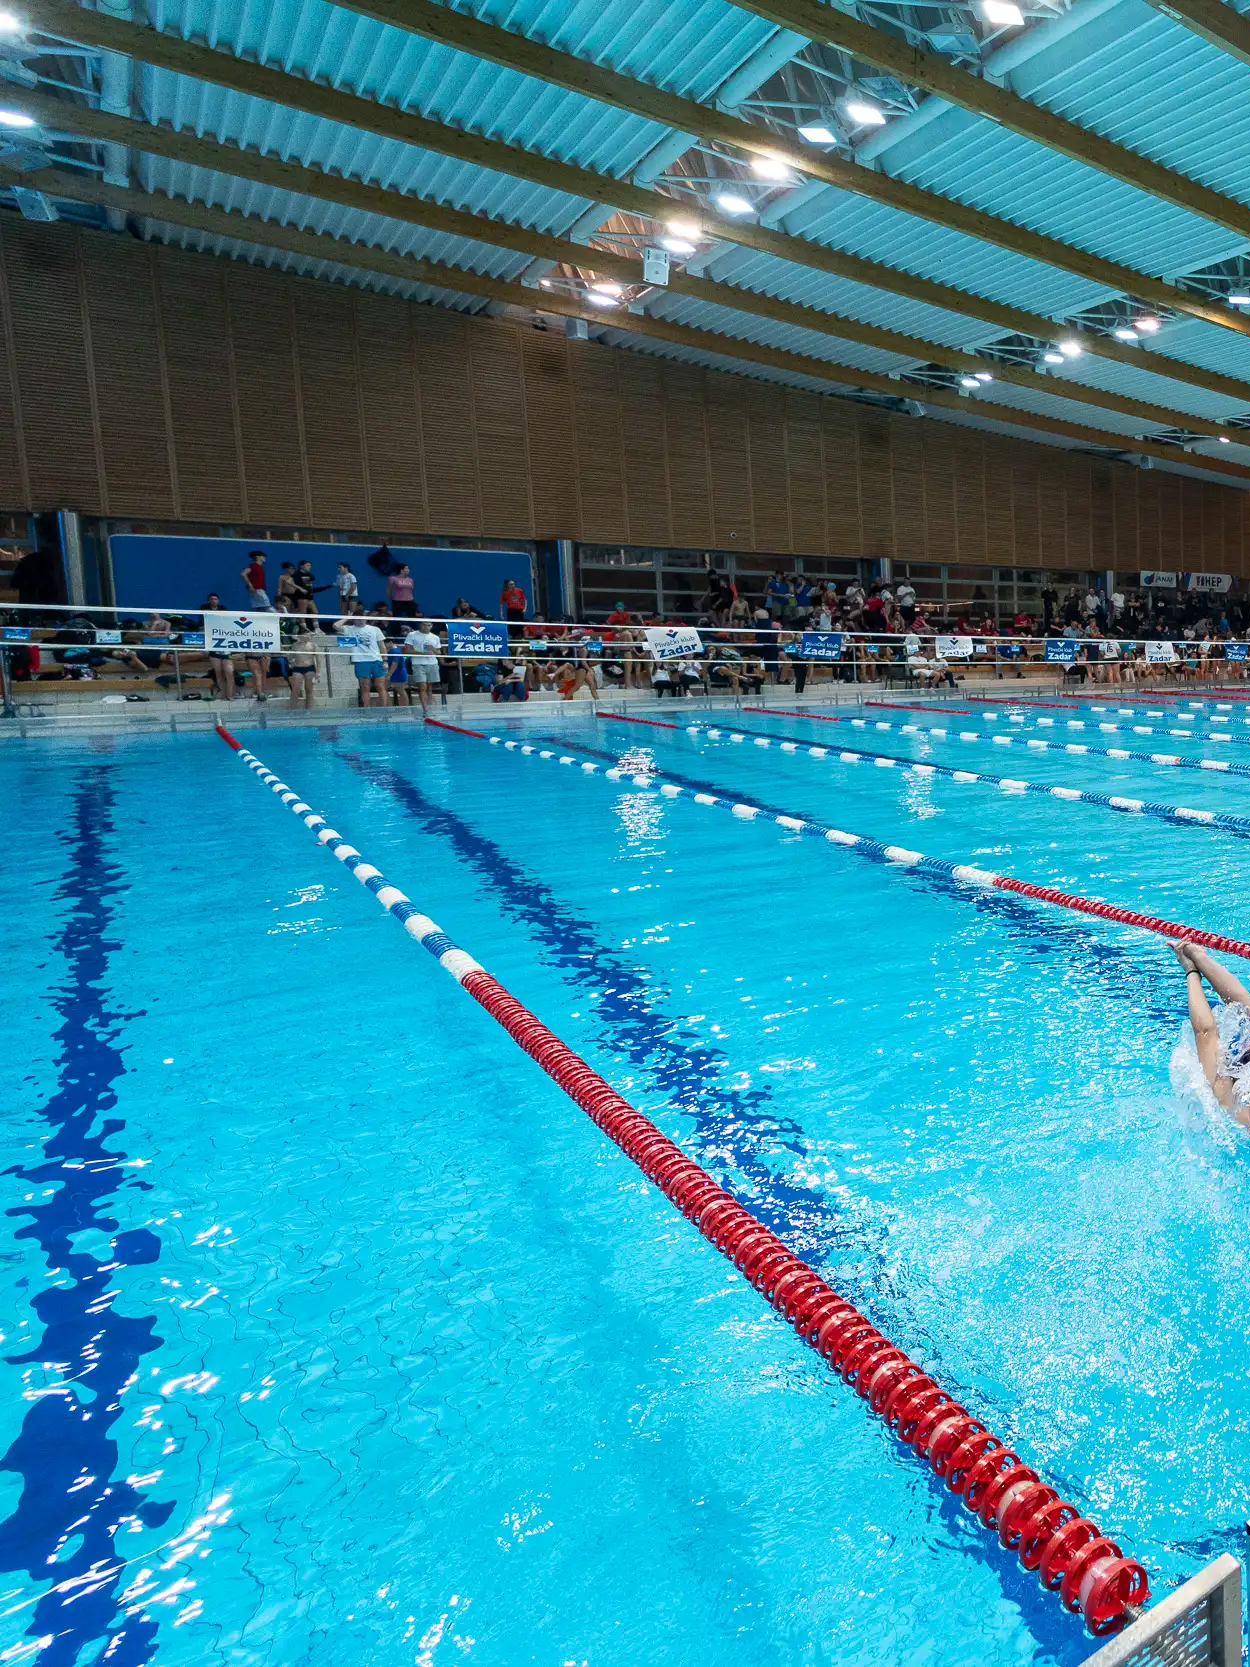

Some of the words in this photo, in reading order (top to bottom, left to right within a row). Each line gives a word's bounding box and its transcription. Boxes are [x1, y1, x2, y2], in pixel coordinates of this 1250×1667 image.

[212, 628, 249, 637] Plivački
[252, 630, 274, 638] klub
[453, 633, 483, 641] Plivački
[212, 637, 274, 650] Zadar
[453, 641, 503, 652] Zadar
[654, 640, 680, 649] Plivački
[680, 635, 695, 643] klub
[657, 643, 698, 658] Zadar
[803, 647, 838, 657] Zadar
[1106, 644, 1113, 653] 15
[1047, 652, 1072, 660] Zadar
